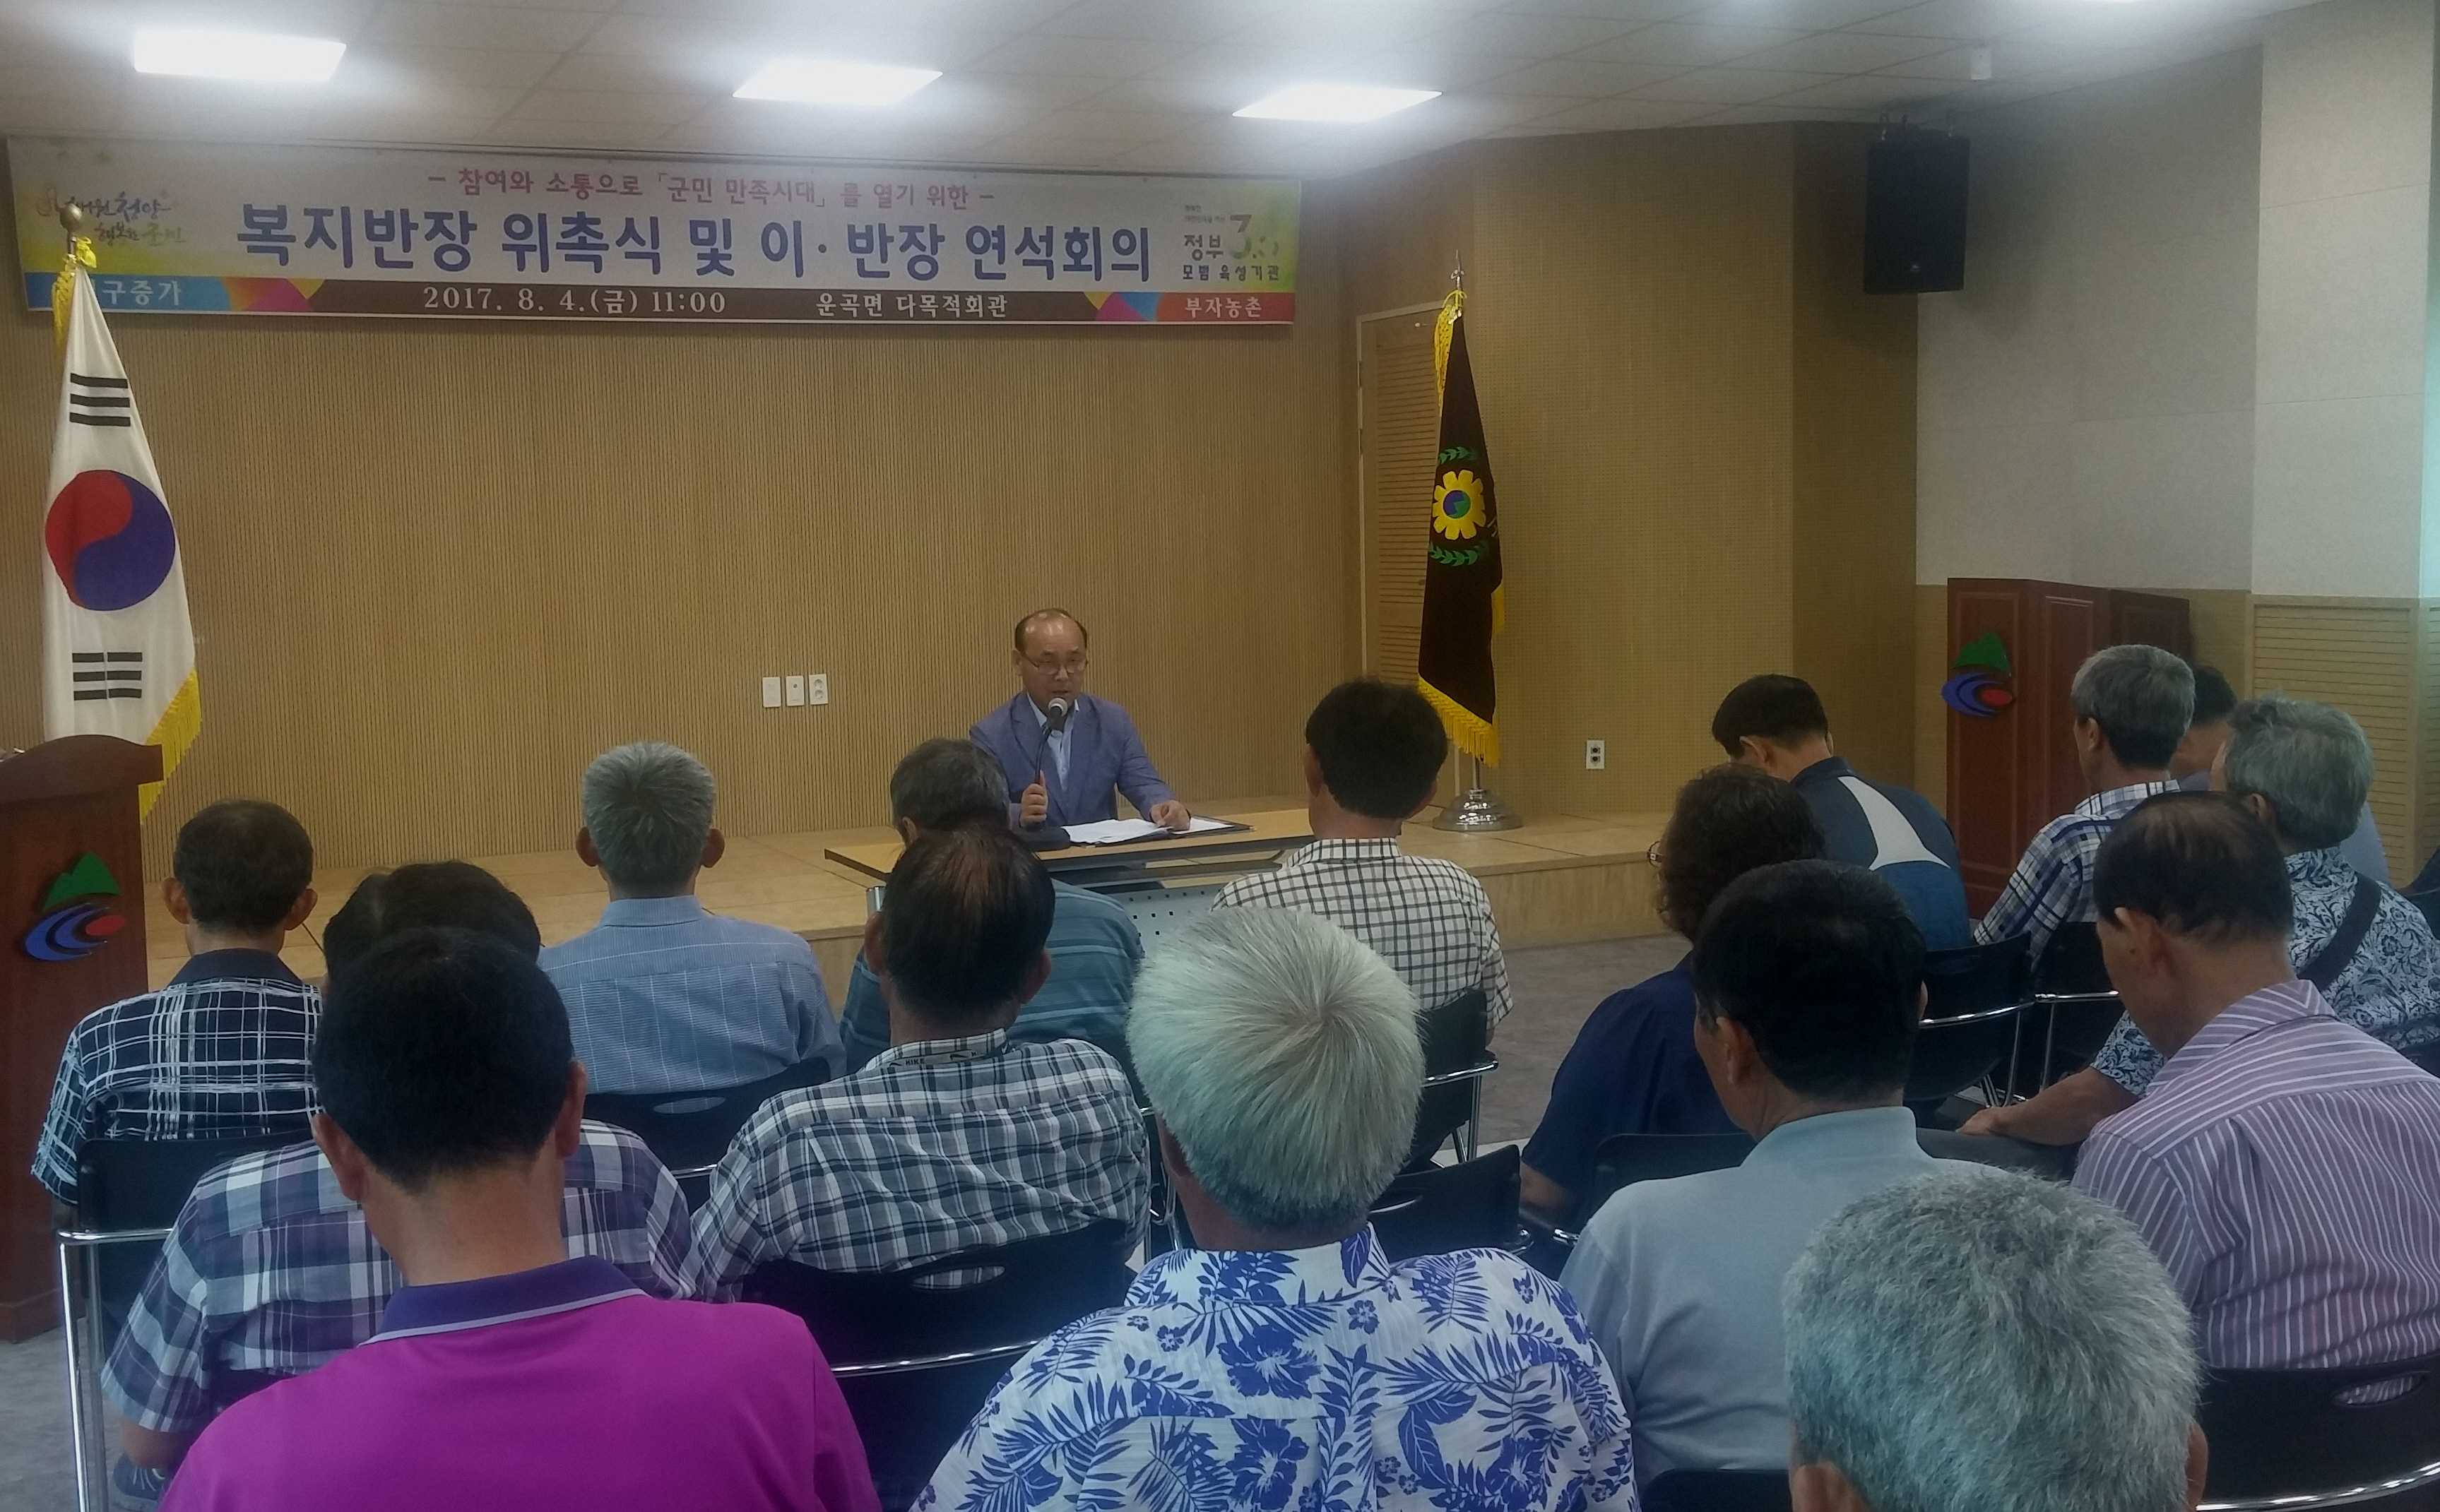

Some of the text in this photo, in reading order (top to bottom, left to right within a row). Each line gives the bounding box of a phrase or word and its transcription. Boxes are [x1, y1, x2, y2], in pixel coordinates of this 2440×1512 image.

[458, 167, 533, 196] 참여와
[546, 172, 643, 201] 소통으로
[658, 172, 712, 203] 「군민
[840, 183, 861, 208] 를
[873, 184, 914, 209] 열기
[927, 184, 969, 210] 위한
[237, 203, 478, 273] 복지반장
[502, 211, 661, 275] 위촉식
[689, 218, 735, 277] 및
[848, 222, 945, 281] 반장
[966, 224, 1150, 282] 연석회의
[1184, 234, 1223, 261] 정부
[1183, 264, 1209, 281] 모범
[423, 286, 726, 314] 2017. 8. 4.(금) 11:00
[816, 292, 1007, 319] 운곡면 다목적회관
[1185, 297, 1262, 319] 부자농촌
